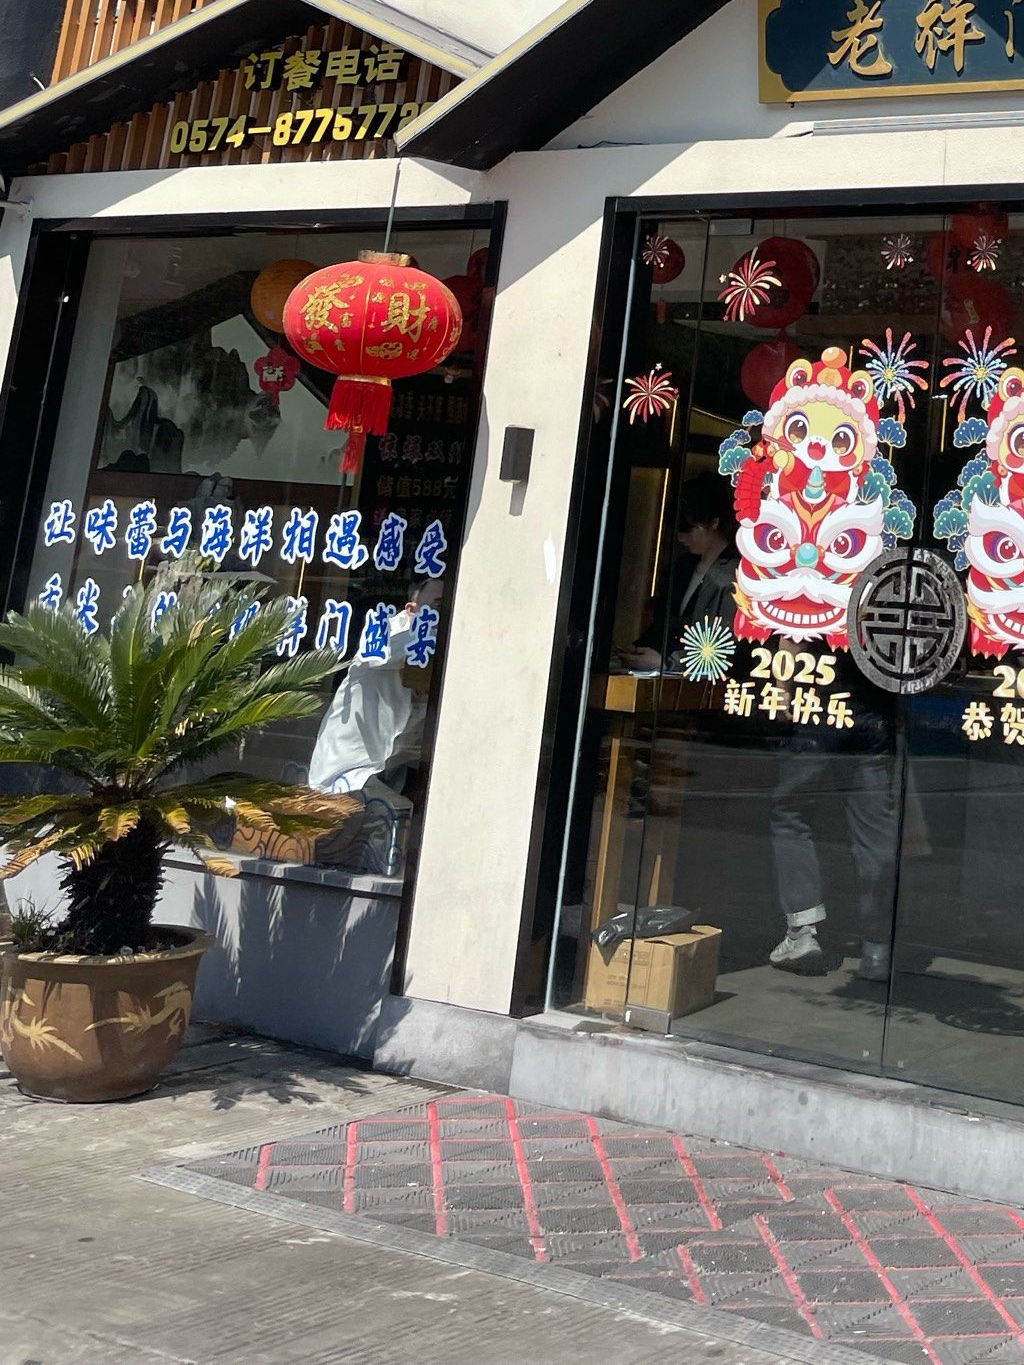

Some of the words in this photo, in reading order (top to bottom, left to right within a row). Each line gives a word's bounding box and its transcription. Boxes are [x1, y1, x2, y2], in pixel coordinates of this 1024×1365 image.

[243, 43, 404, 91] 订餐电话
[170, 101, 436, 154] 0574-8775772
[750, 647, 837, 686] 2025
[723, 678, 855, 729] 新年快乐
